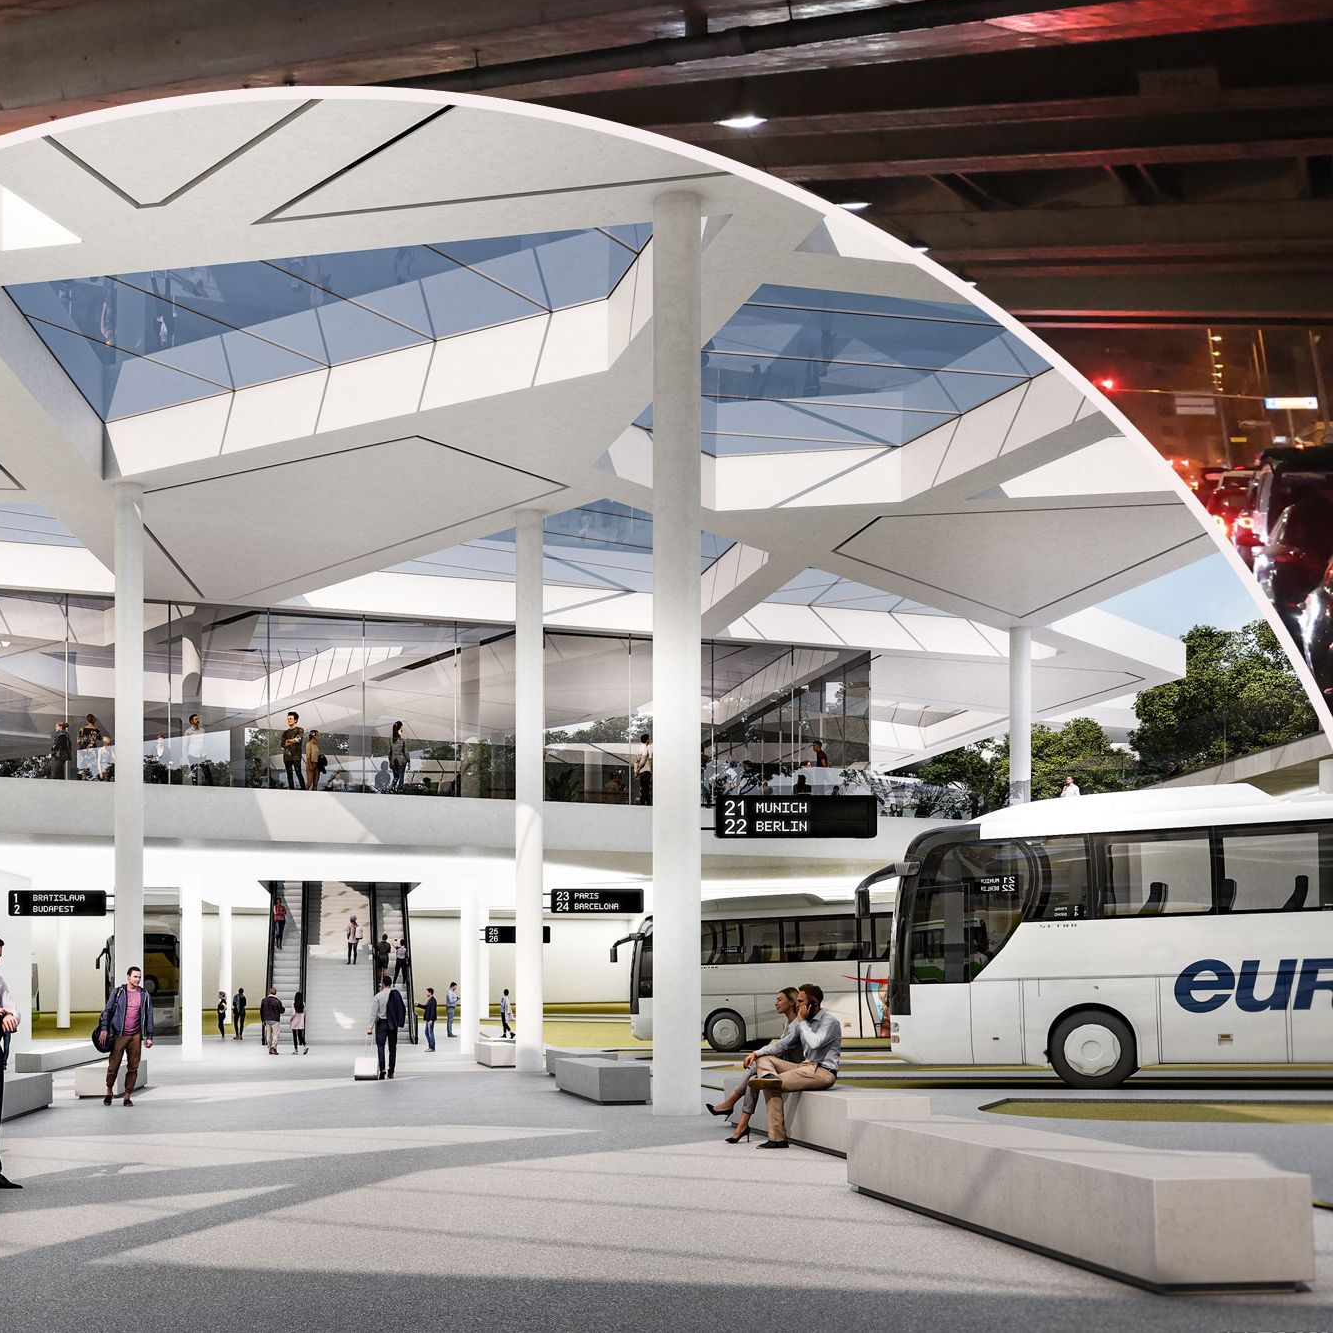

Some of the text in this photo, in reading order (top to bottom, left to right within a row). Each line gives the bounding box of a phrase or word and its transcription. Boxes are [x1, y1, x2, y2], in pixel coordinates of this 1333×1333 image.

[724, 800, 808, 816] 21 MUNICH
[724, 819, 808, 834] 22 BERLIN
[13, 893, 86, 903] 1 BRATISLAVA
[556, 891, 599, 901] 23 PARIS
[13, 904, 74, 914] 2 BUDAPEST
[556, 902, 570, 912] 24
